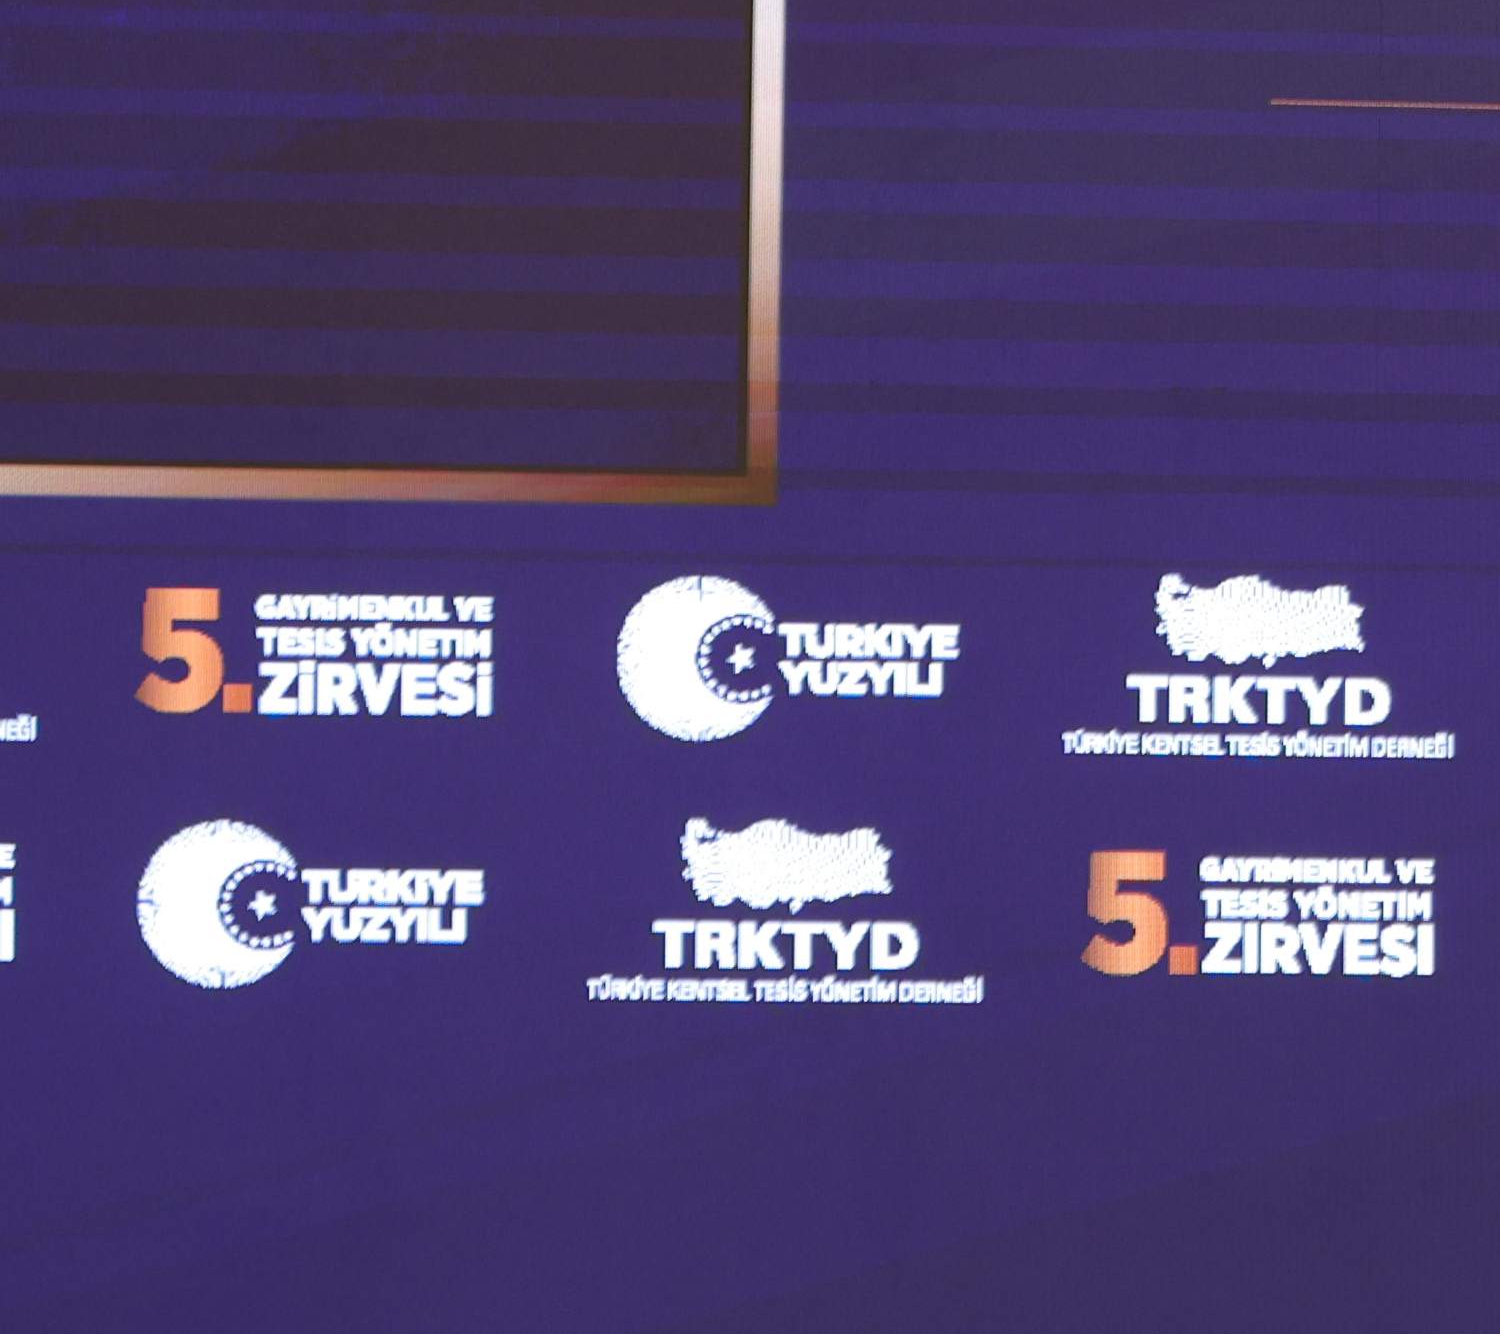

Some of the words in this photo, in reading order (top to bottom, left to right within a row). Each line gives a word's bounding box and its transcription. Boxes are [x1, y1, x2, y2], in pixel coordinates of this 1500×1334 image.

[455, 597, 494, 623] VE
[137, 586, 253, 713] 5.
[1127, 675, 1392, 726] TRKTYD
[1396, 860, 1435, 885] VE
[1082, 850, 1198, 975] 5.
[653, 921, 920, 971] TRKTYD
